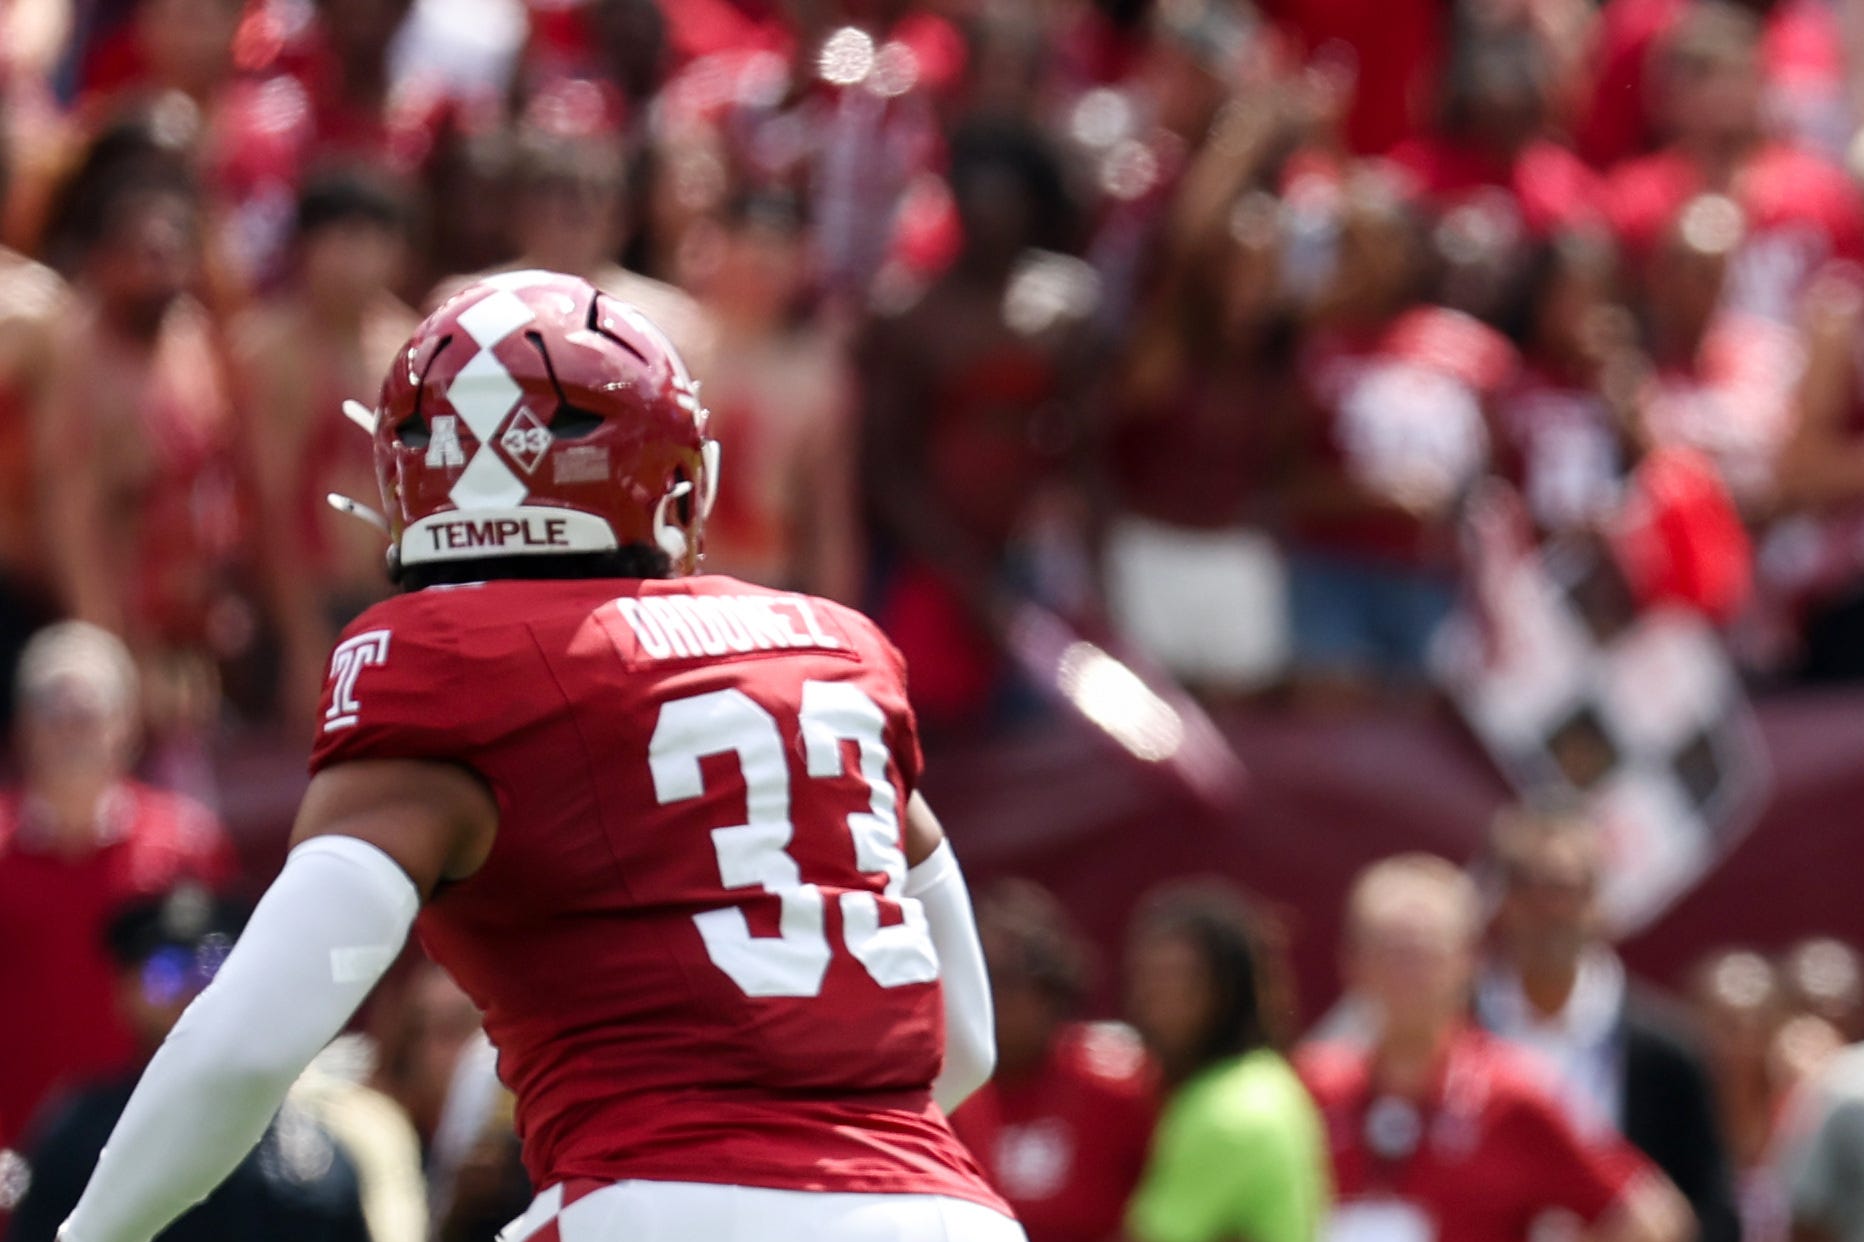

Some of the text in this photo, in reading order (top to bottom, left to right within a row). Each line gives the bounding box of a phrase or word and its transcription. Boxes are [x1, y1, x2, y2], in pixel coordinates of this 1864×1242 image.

[505, 428, 553, 454] 33
[426, 518, 569, 551] TEMPLE
[323, 628, 393, 734] T
[648, 679, 941, 998] 33
